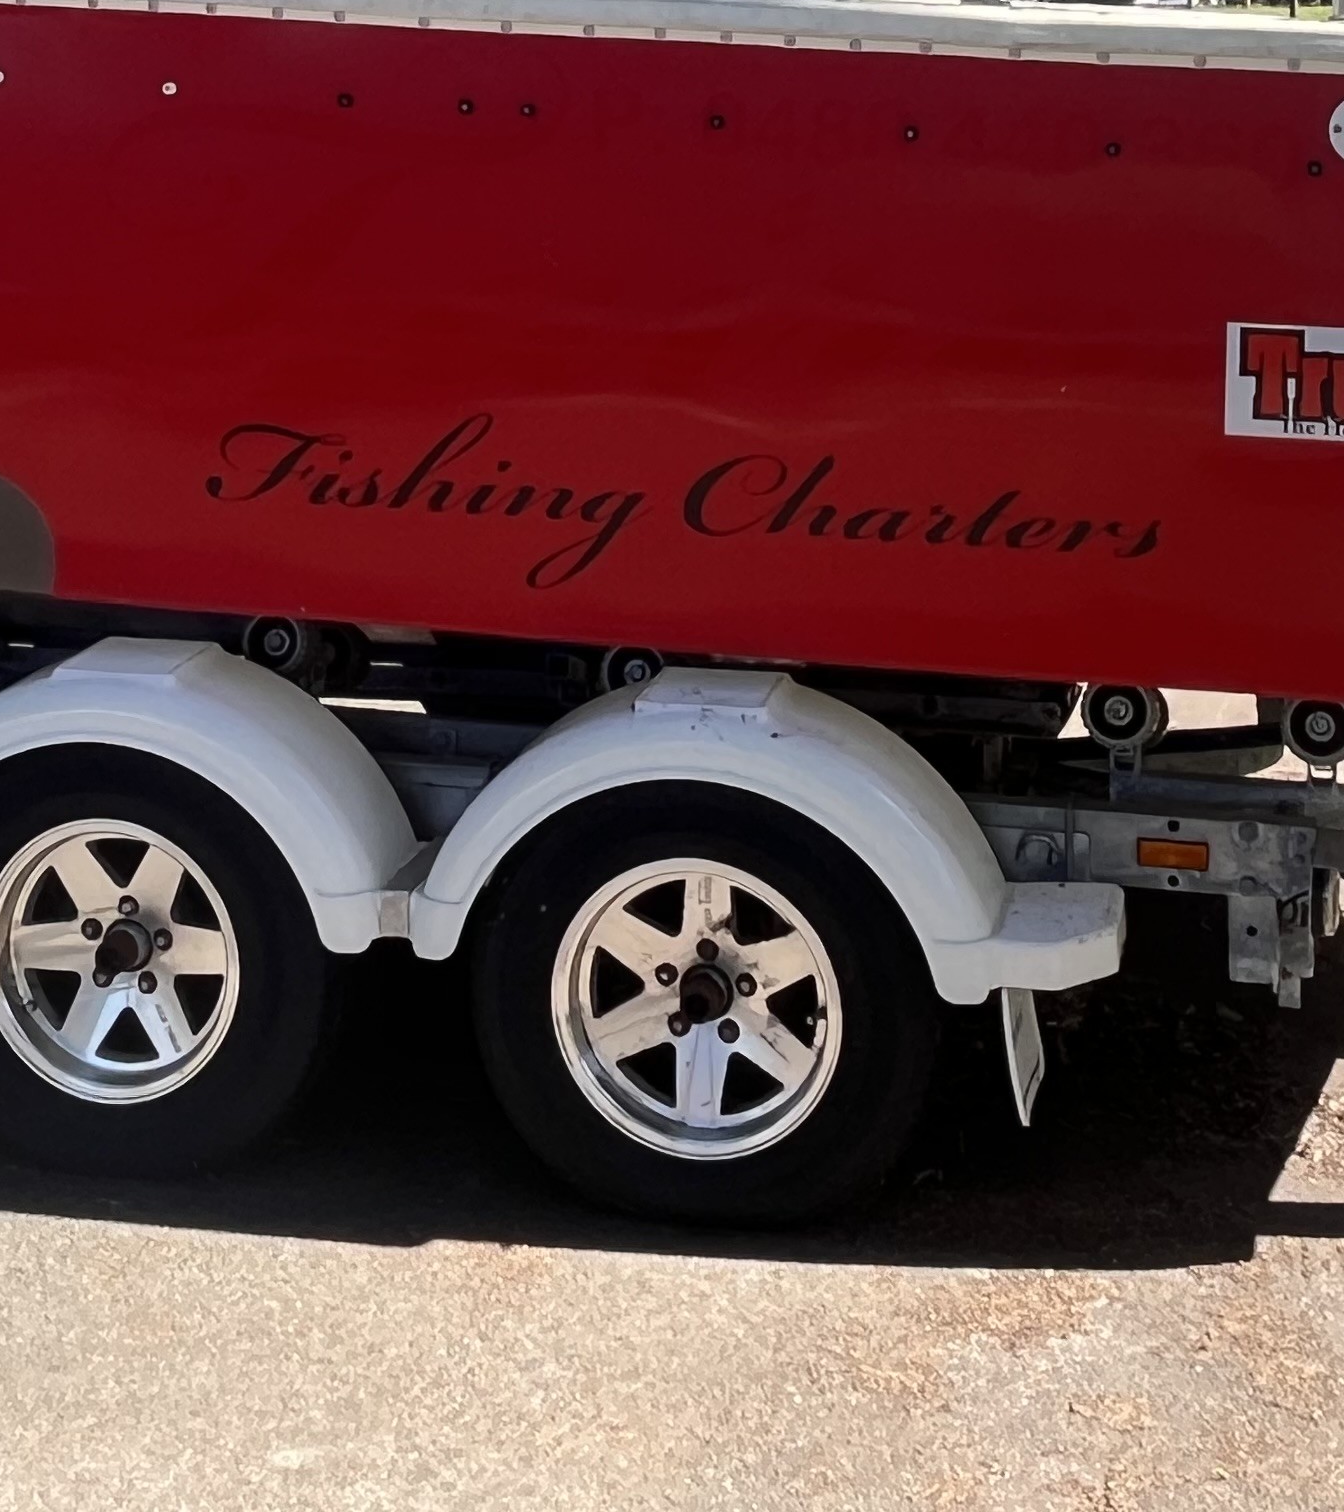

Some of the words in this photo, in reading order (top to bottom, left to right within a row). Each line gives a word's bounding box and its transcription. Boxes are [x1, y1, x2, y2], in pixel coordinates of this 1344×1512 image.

[1283, 420, 1316, 435] The
[205, 411, 650, 589] Fishing
[683, 453, 1160, 559] Charters
